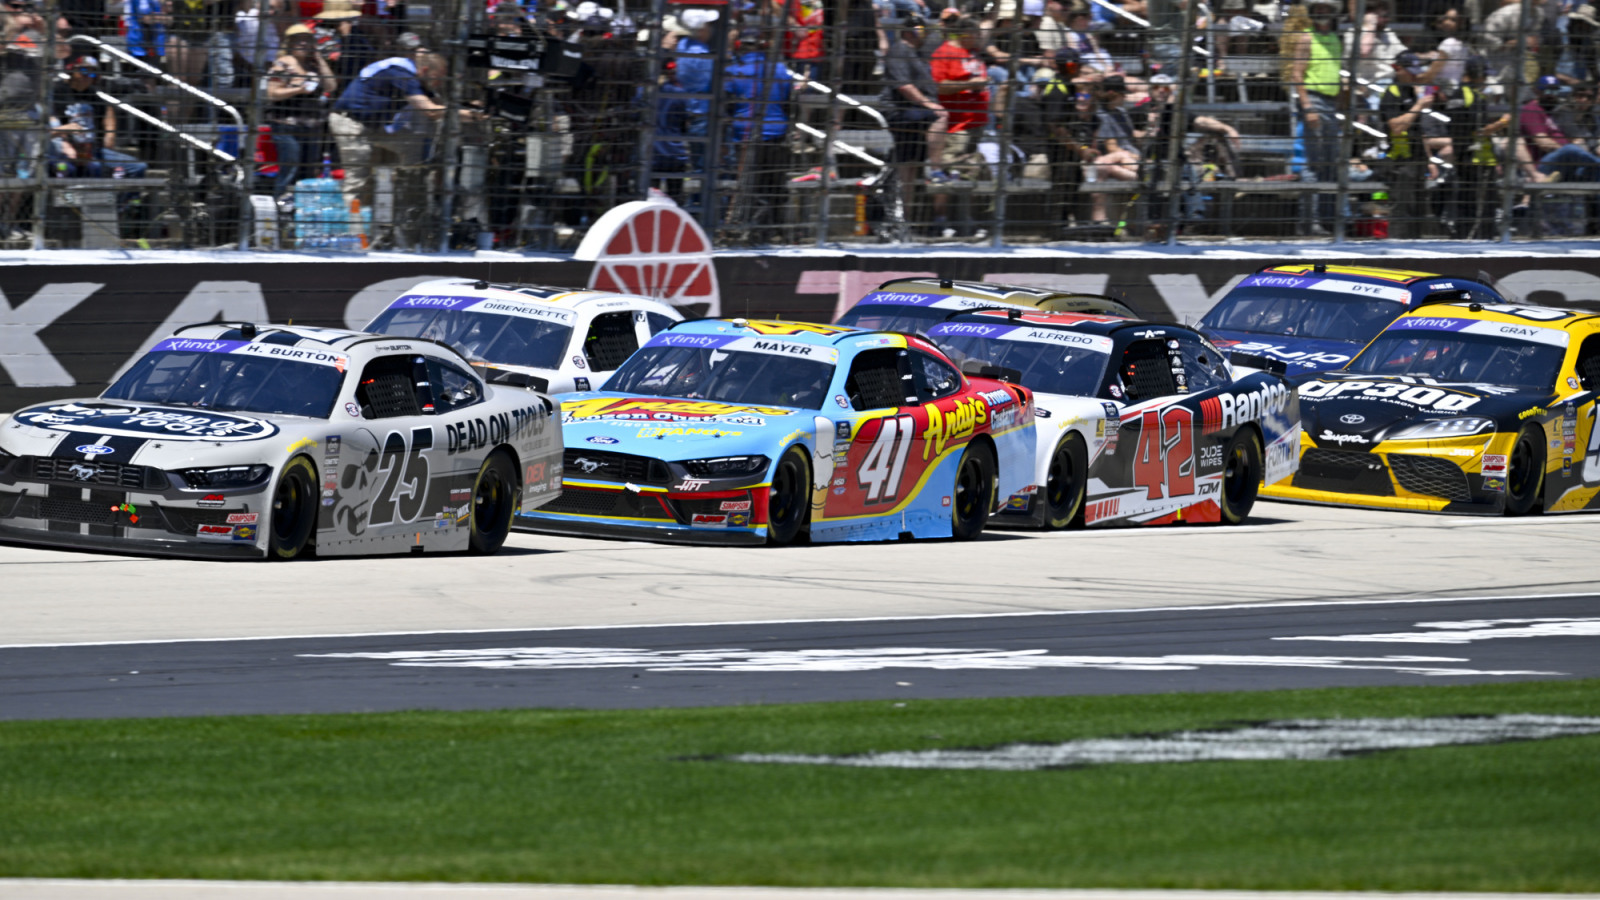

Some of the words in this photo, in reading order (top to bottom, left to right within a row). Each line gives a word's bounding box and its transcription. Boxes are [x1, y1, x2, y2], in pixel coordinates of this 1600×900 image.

[1251, 275, 1304, 288] xfinity
[1351, 284, 1383, 295] DYE
[404, 296, 463, 308] xfinity
[873, 292, 928, 305] xfinity
[938, 322, 997, 336] xfinity
[1403, 317, 1459, 329] xfinity
[1027, 330, 1094, 346] ALFREDO
[1500, 325, 1539, 338] GRAY
[166, 339, 228, 352] xfinity
[659, 334, 720, 348] xfinity
[246, 345, 264, 353] H.
[270, 347, 339, 362] BURTON
[752, 341, 813, 356] MAYER
[1218, 381, 1287, 430] Randco
[136, 410, 210, 425] DEAD
[445, 417, 488, 457] DEAD
[489, 411, 511, 446] ON
[511, 403, 546, 442] TOOLS
[923, 396, 987, 462] Andy's
[1319, 430, 1370, 447] Supra
[1133, 404, 1195, 501] 42
[1200, 445, 1223, 459] DUDE
[857, 414, 915, 506] 41
[1200, 457, 1223, 468] WIPES
[1482, 455, 1505, 464] SIMPSON
[367, 425, 434, 528] 25
[525, 461, 547, 485] DEX
[720, 502, 750, 510] SIMPSON
[229, 514, 257, 523] SIMPSON
